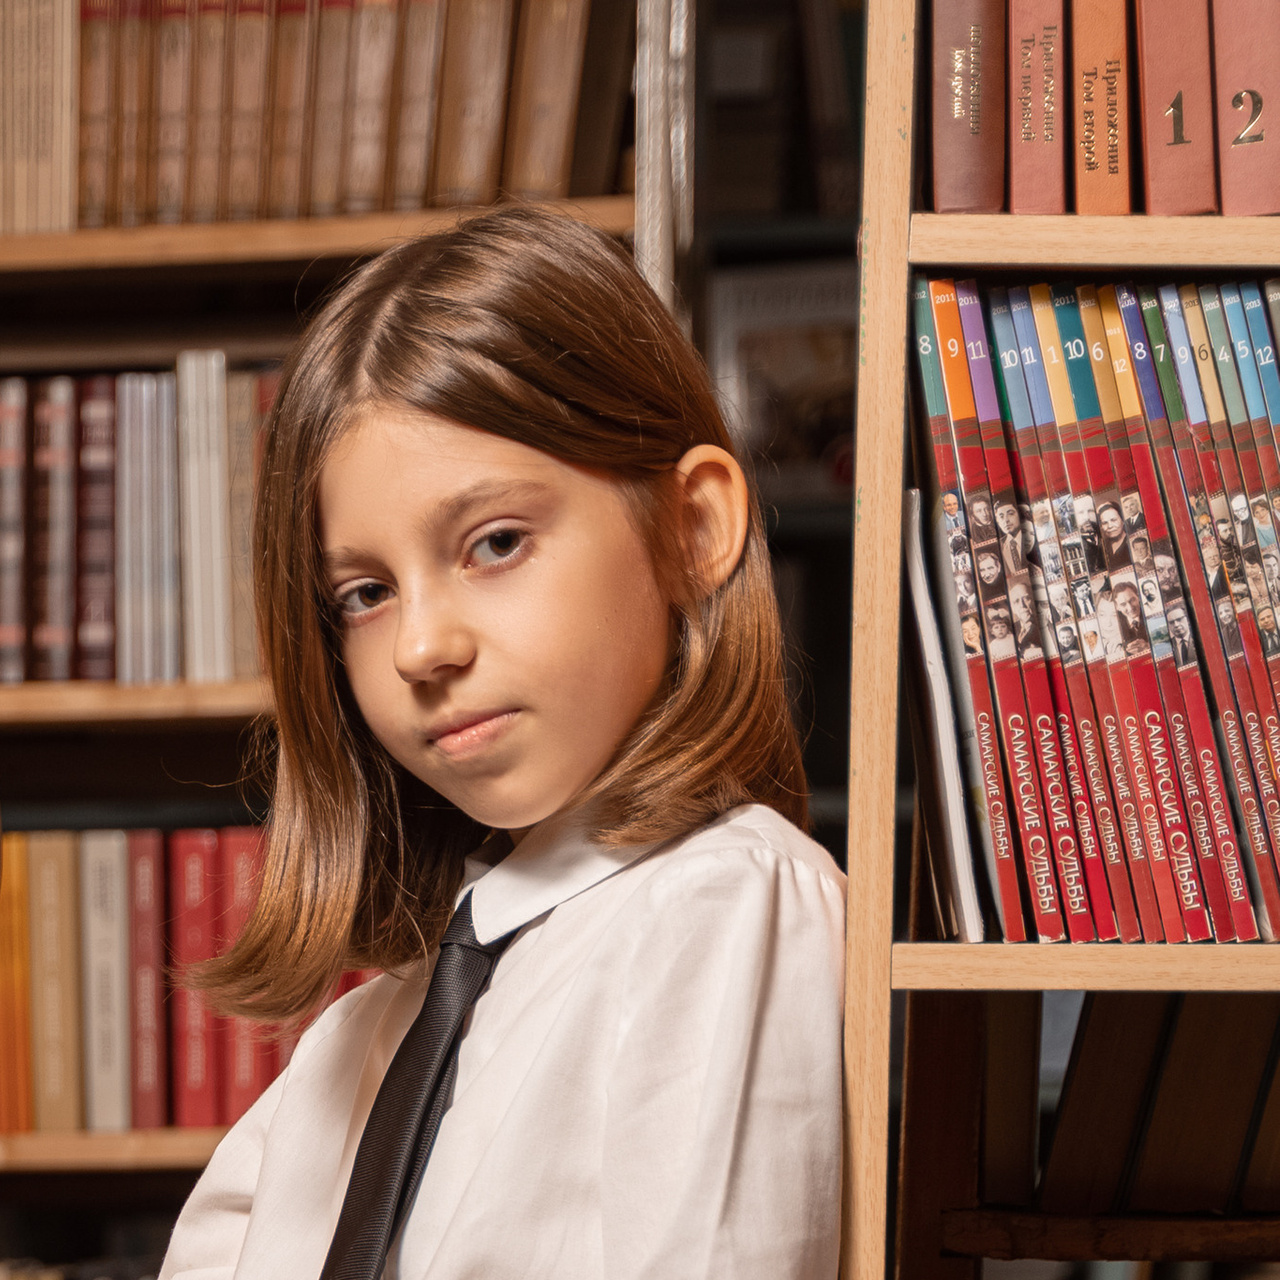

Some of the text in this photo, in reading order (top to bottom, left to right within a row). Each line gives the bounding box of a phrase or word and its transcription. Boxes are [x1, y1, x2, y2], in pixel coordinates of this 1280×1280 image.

[1018, 33, 1036, 143] Том первый
[1040, 24, 1057, 145] Приложения
[1080, 67, 1100, 174] Том второй
[1103, 58, 1121, 177] Приложения
[1165, 90, 1192, 146] 1
[1231, 89, 1265, 149] 2
[935, 292, 956, 304] 2011
[958, 295, 978, 307] 2011
[1053, 295, 1075, 307] 2011
[1141, 300, 1158, 311] 2013
[1184, 298, 1200, 309] 2013
[1224, 295, 1240, 306] 2013
[1245, 299, 1262, 310] 2013
[1268, 292, 1280, 303] 201
[919, 335, 932, 355] 8
[947, 338, 959, 358] 9
[967, 340, 986, 361] 11
[1021, 345, 1037, 366] 11
[1047, 345, 1059, 365] 1
[1064, 338, 1085, 360] 10
[1091, 341, 1104, 361] 6
[1133, 342, 1147, 360] 8
[1154, 344, 1165, 362] 7
[1177, 346, 1189, 365] 9
[1198, 343, 1209, 361] 6
[1218, 345, 1230, 363] 4
[1237, 340, 1249, 359] 5
[1256, 345, 1275, 366] 12
[1000, 349, 1018, 369] 10
[1113, 358, 1128, 374] 12
[1245, 712, 1276, 798] САМАРСКИЕ
[977, 712, 1010, 859] САМАРСКИЕ СУДЬБЫ
[1058, 713, 1097, 859] САМАРСКИЕ СУДЬБЫ
[1079, 719, 1121, 865] САМАРСКИЕ СУДЬБЫ
[1103, 715, 1145, 861] САМАРСКИЕ СУДЬБЫ
[1124, 715, 1166, 862] САМАРСКИЕ СУДЬБЫ
[1170, 712, 1214, 859] САМАРСКИЕ СУДЬБЫ
[1223, 710, 1268, 856] САМАРСКИЕ СУДЬБЫ
[1007, 713, 1057, 915] САМАРСКИЕ СУДЬБЫ
[1035, 714, 1087, 915] САМАРСКИЕ СУДЬБЫ
[1144, 711, 1201, 911] САМАРСКИЕ СУДЬБЫ
[1200, 748, 1245, 903] САМАРСКИЕ СУДЬБЫ
